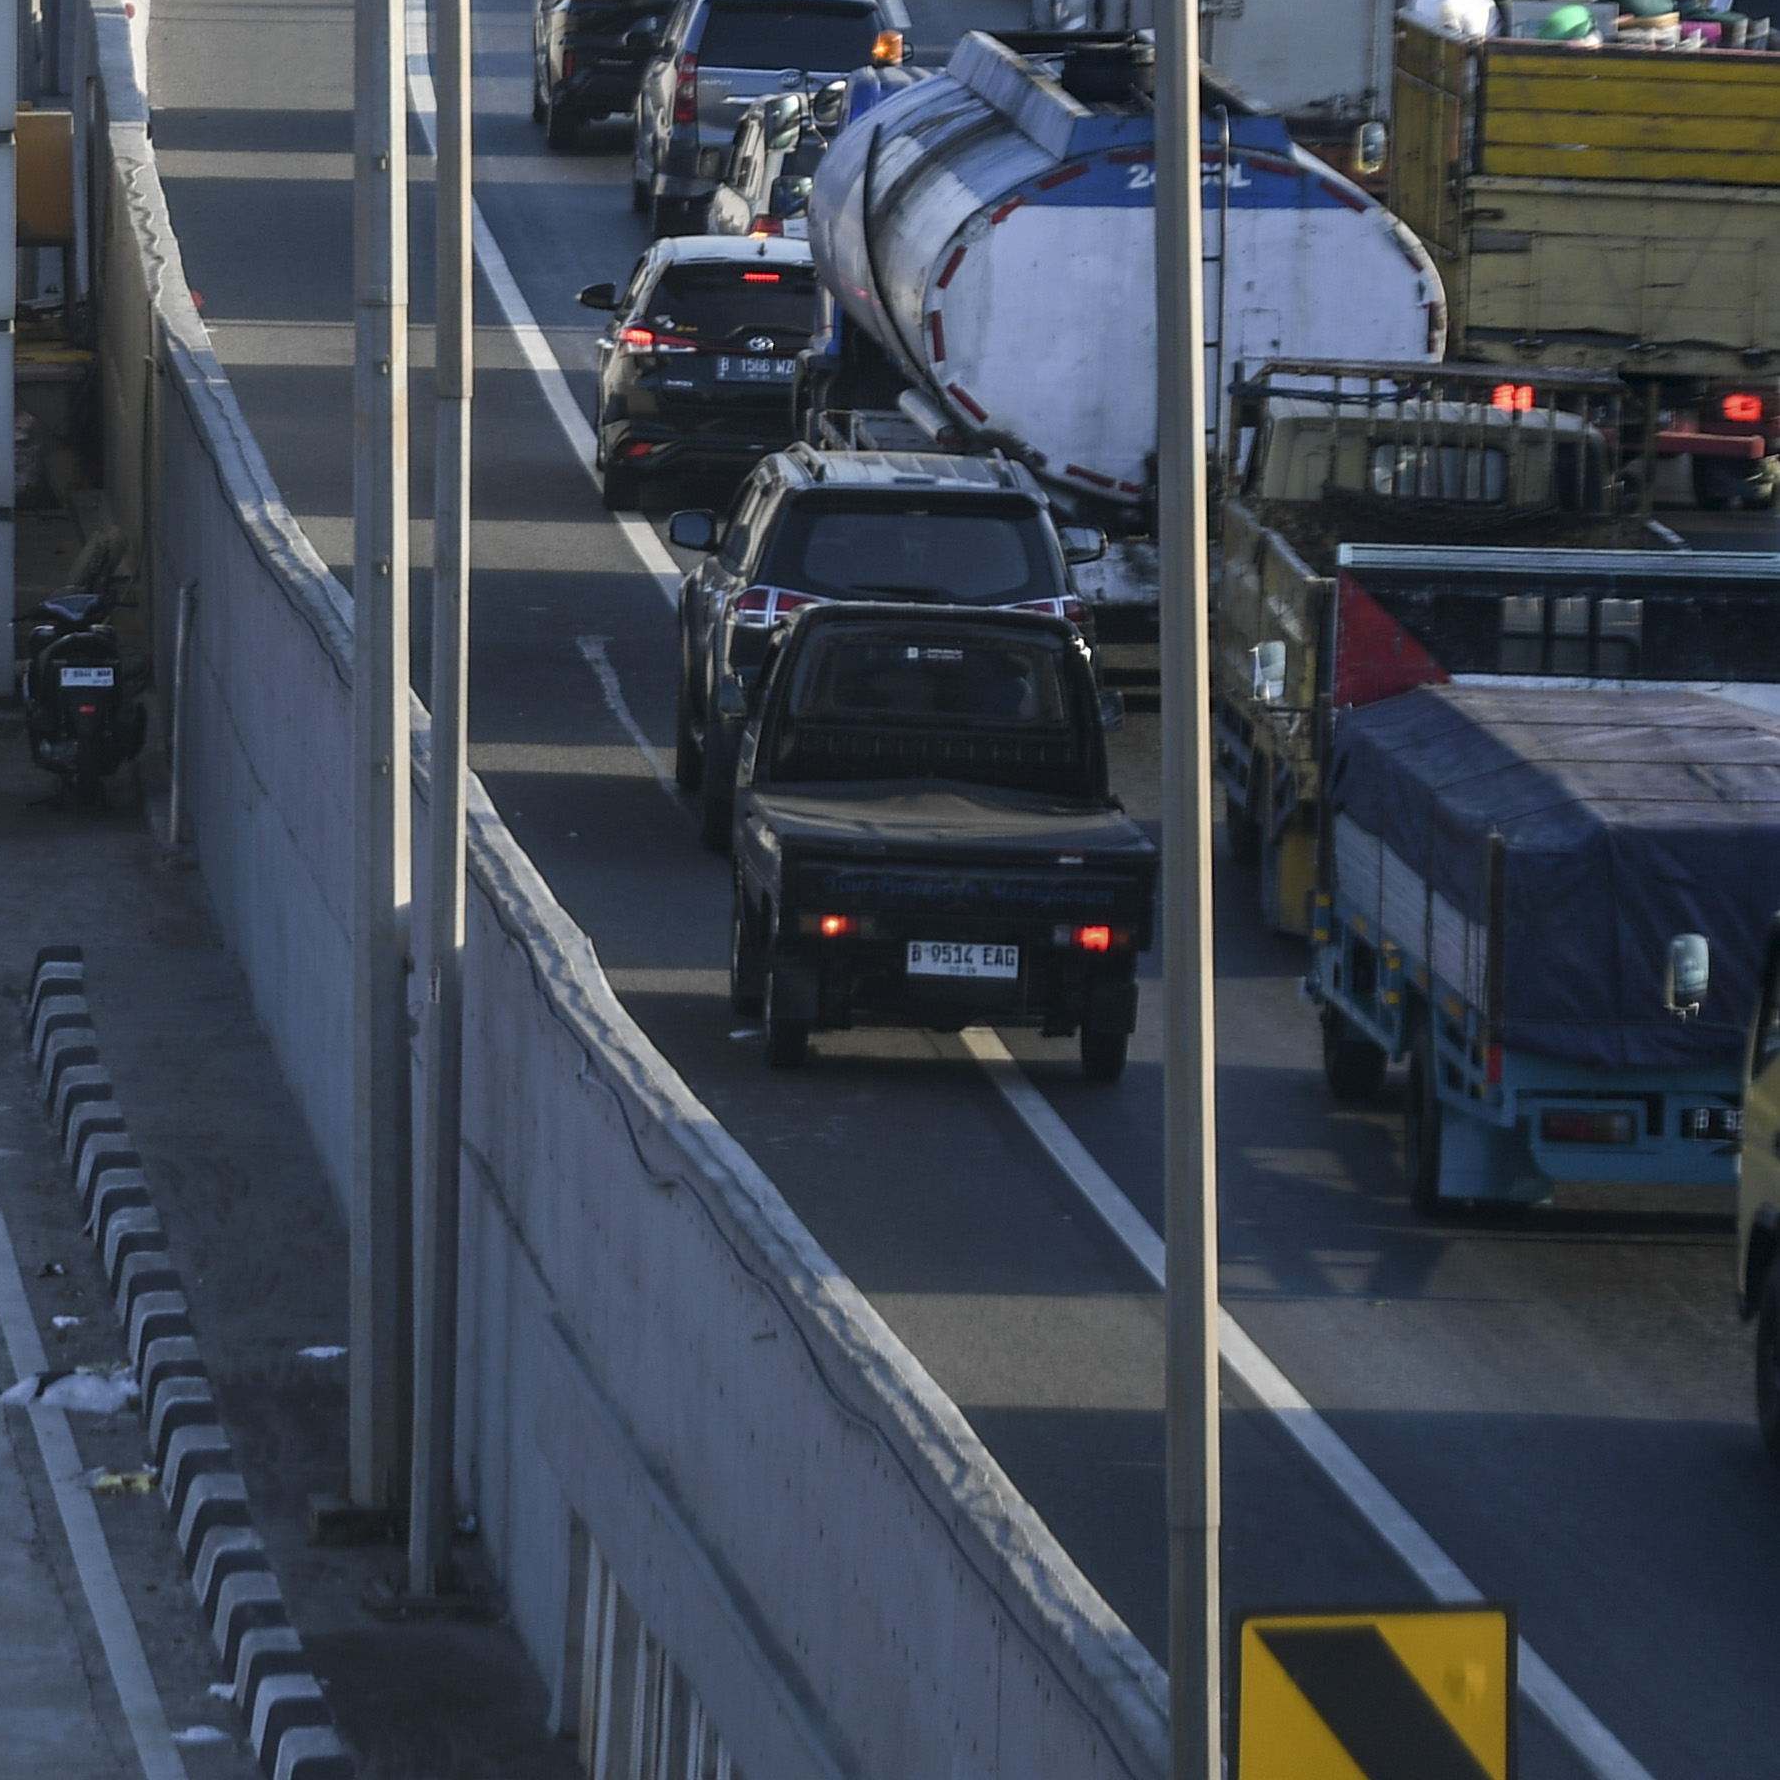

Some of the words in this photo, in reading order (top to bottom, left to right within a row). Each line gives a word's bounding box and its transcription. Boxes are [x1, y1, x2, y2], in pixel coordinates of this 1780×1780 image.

[721, 358, 730, 371] B
[911, 945, 922, 962] B
[931, 946, 974, 965] 9514
[982, 947, 1016, 967] EAG
